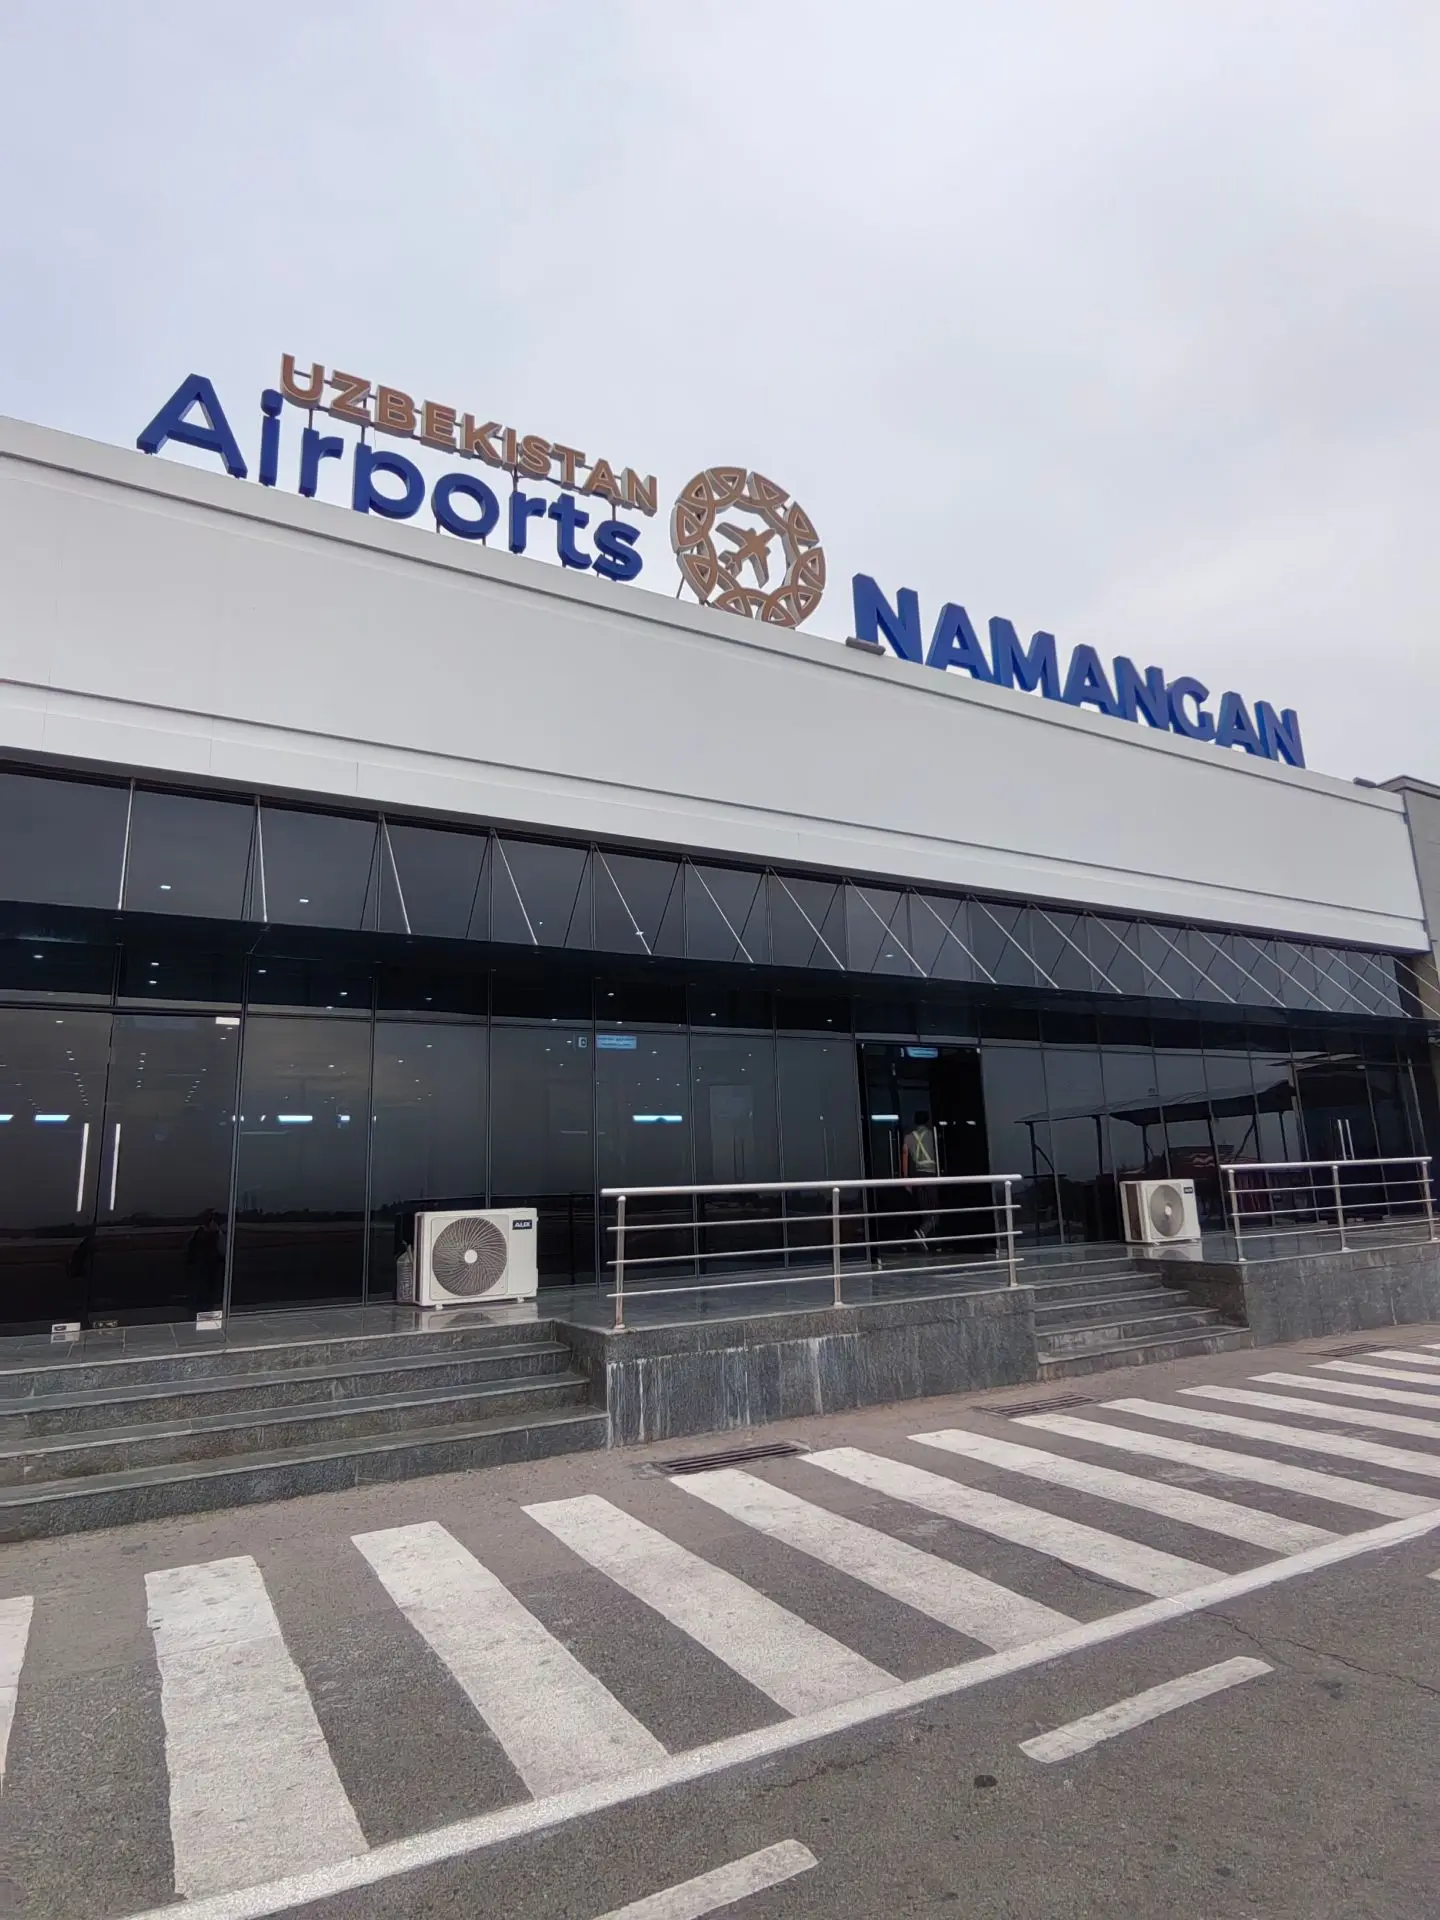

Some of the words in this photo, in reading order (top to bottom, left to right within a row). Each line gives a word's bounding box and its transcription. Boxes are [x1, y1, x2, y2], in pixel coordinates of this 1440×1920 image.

[137, 374, 643, 581] Airports
[281, 353, 657, 516] UZBEKISTAN
[852, 574, 1306, 769] NAMANGAN
